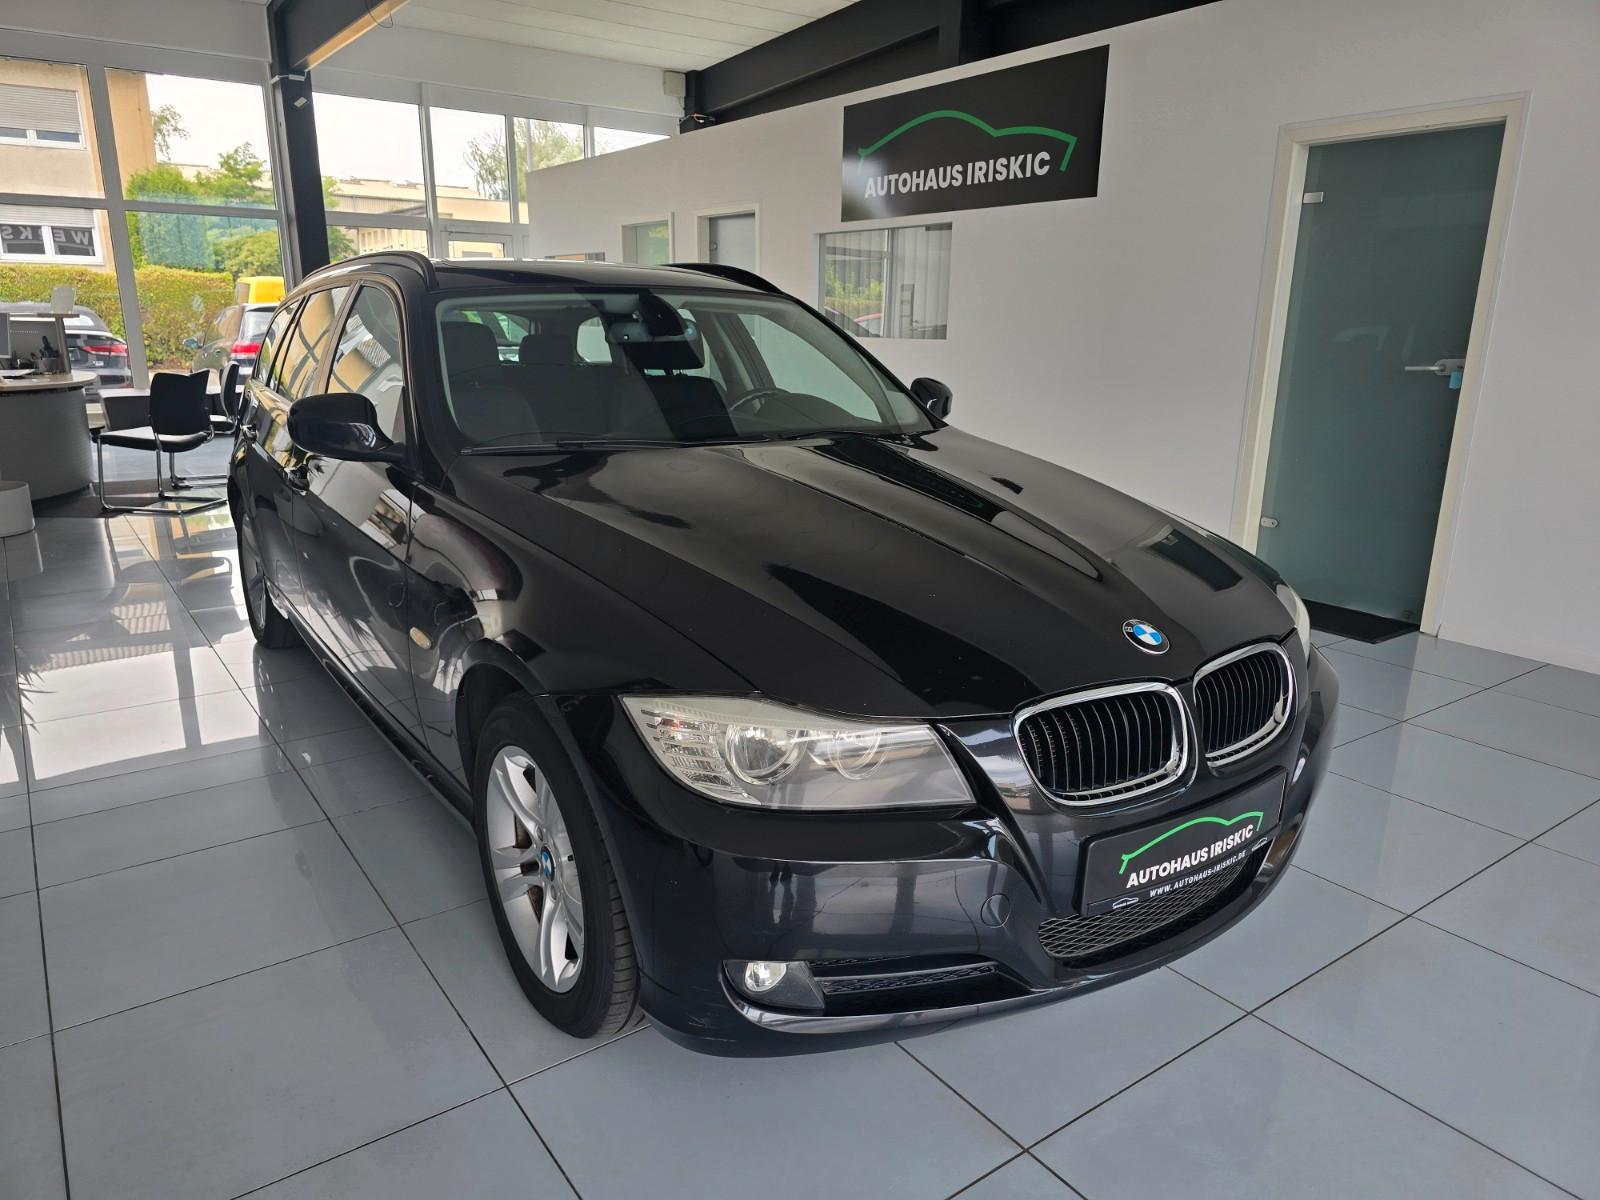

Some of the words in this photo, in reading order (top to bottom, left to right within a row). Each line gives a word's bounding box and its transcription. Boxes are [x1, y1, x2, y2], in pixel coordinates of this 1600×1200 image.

[864, 164, 963, 199] AUTOHAUS
[966, 151, 1051, 185] IRISKIC
[1126, 848, 1209, 889] AUTOHAUS
[1209, 824, 1254, 858] IRISKIC
